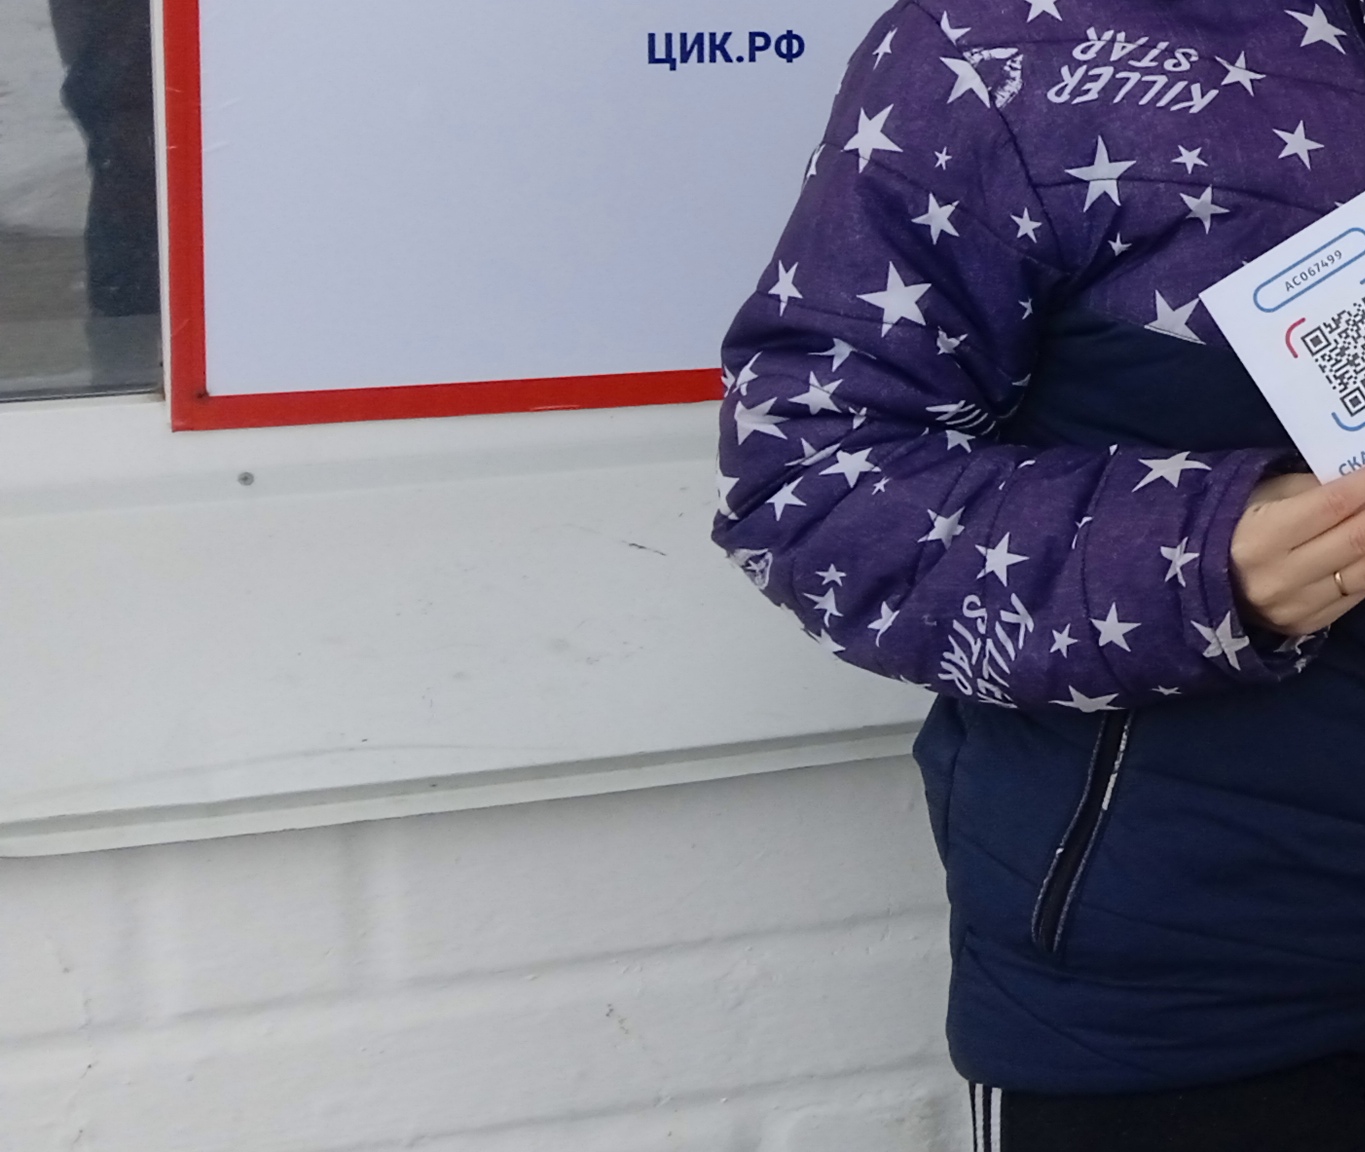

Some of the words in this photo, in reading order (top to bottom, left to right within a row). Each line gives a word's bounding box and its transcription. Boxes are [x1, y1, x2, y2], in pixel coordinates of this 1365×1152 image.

[647, 30, 805, 70] ЦИК.РФ
[1072, 26, 1199, 71] STAR
[1047, 64, 1219, 113] KILLER
